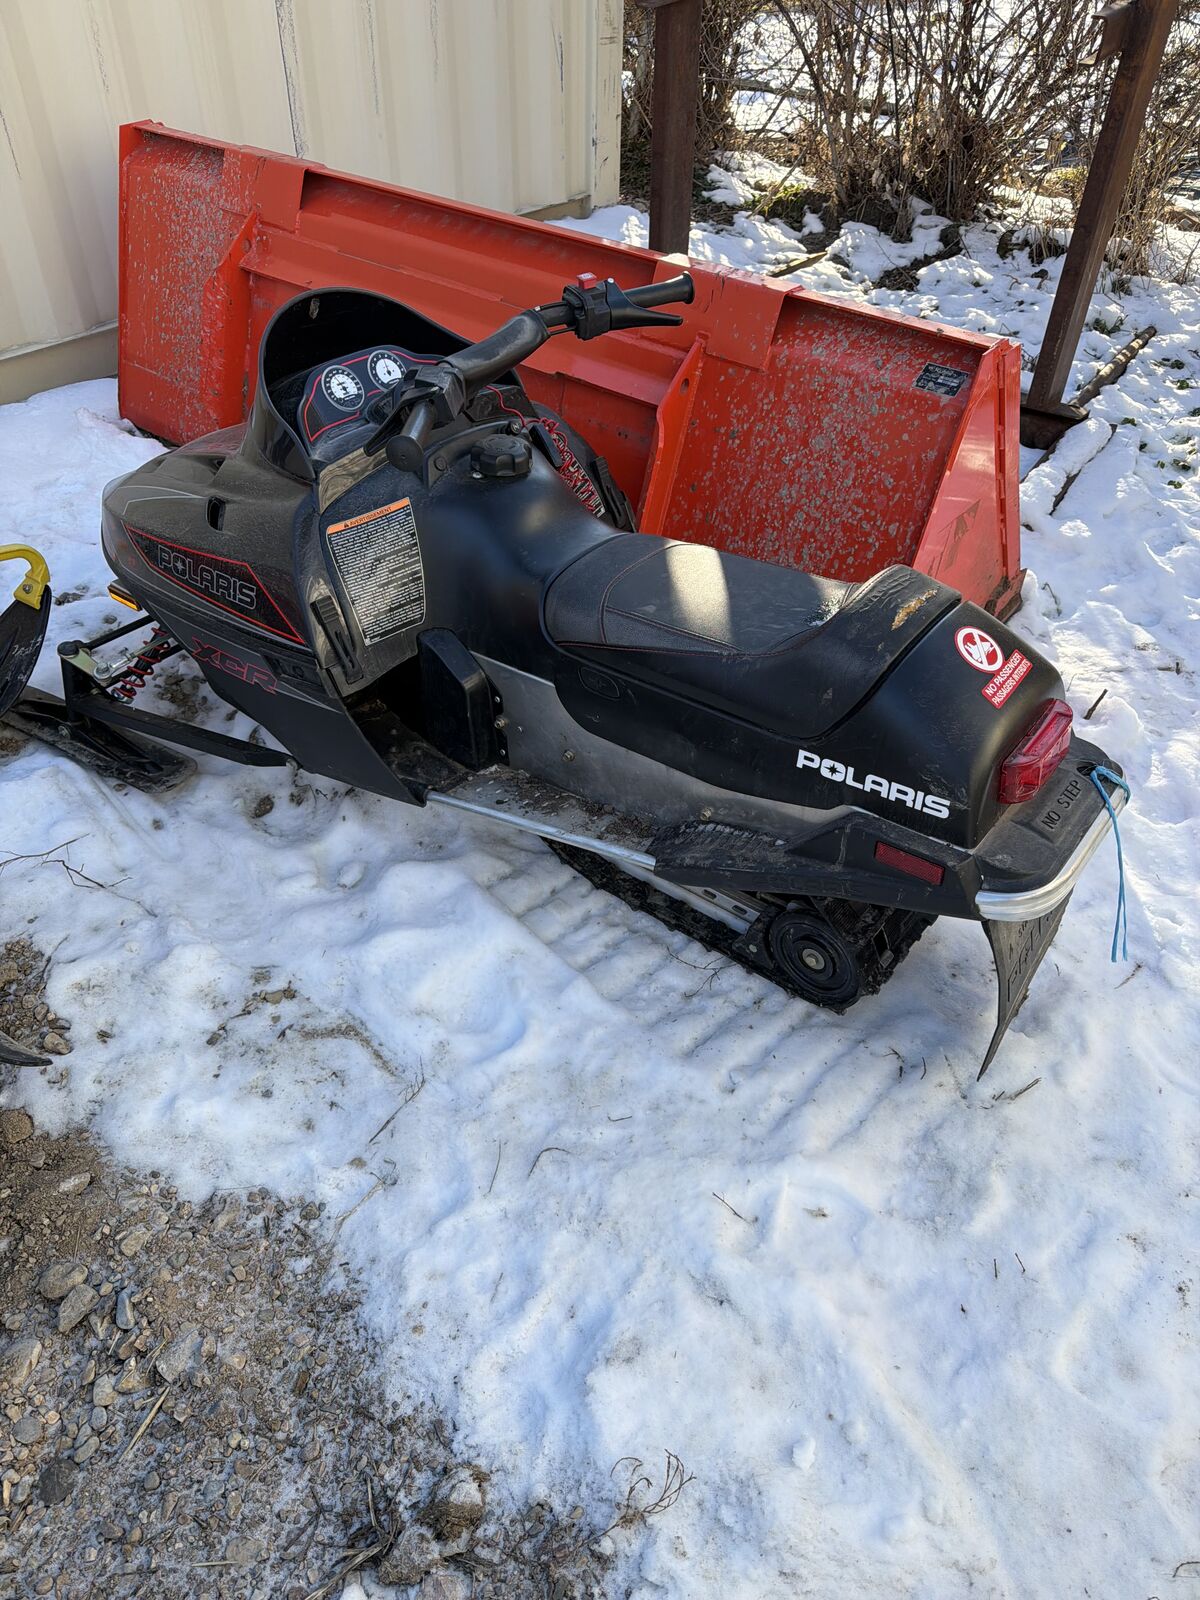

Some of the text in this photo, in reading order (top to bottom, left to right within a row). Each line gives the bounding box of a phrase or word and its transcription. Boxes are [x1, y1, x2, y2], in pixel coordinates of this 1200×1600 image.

[349, 506, 392, 527] AVERTISSEMENT
[157, 544, 257, 610] POLARIS
[192, 636, 278, 695] XCR
[985, 652, 1022, 697] NO PASSENGER
[991, 677, 1016, 707] PASSAGERS
[795, 749, 951, 819] POLARIS
[1041, 779, 1082, 830] NO STEP
